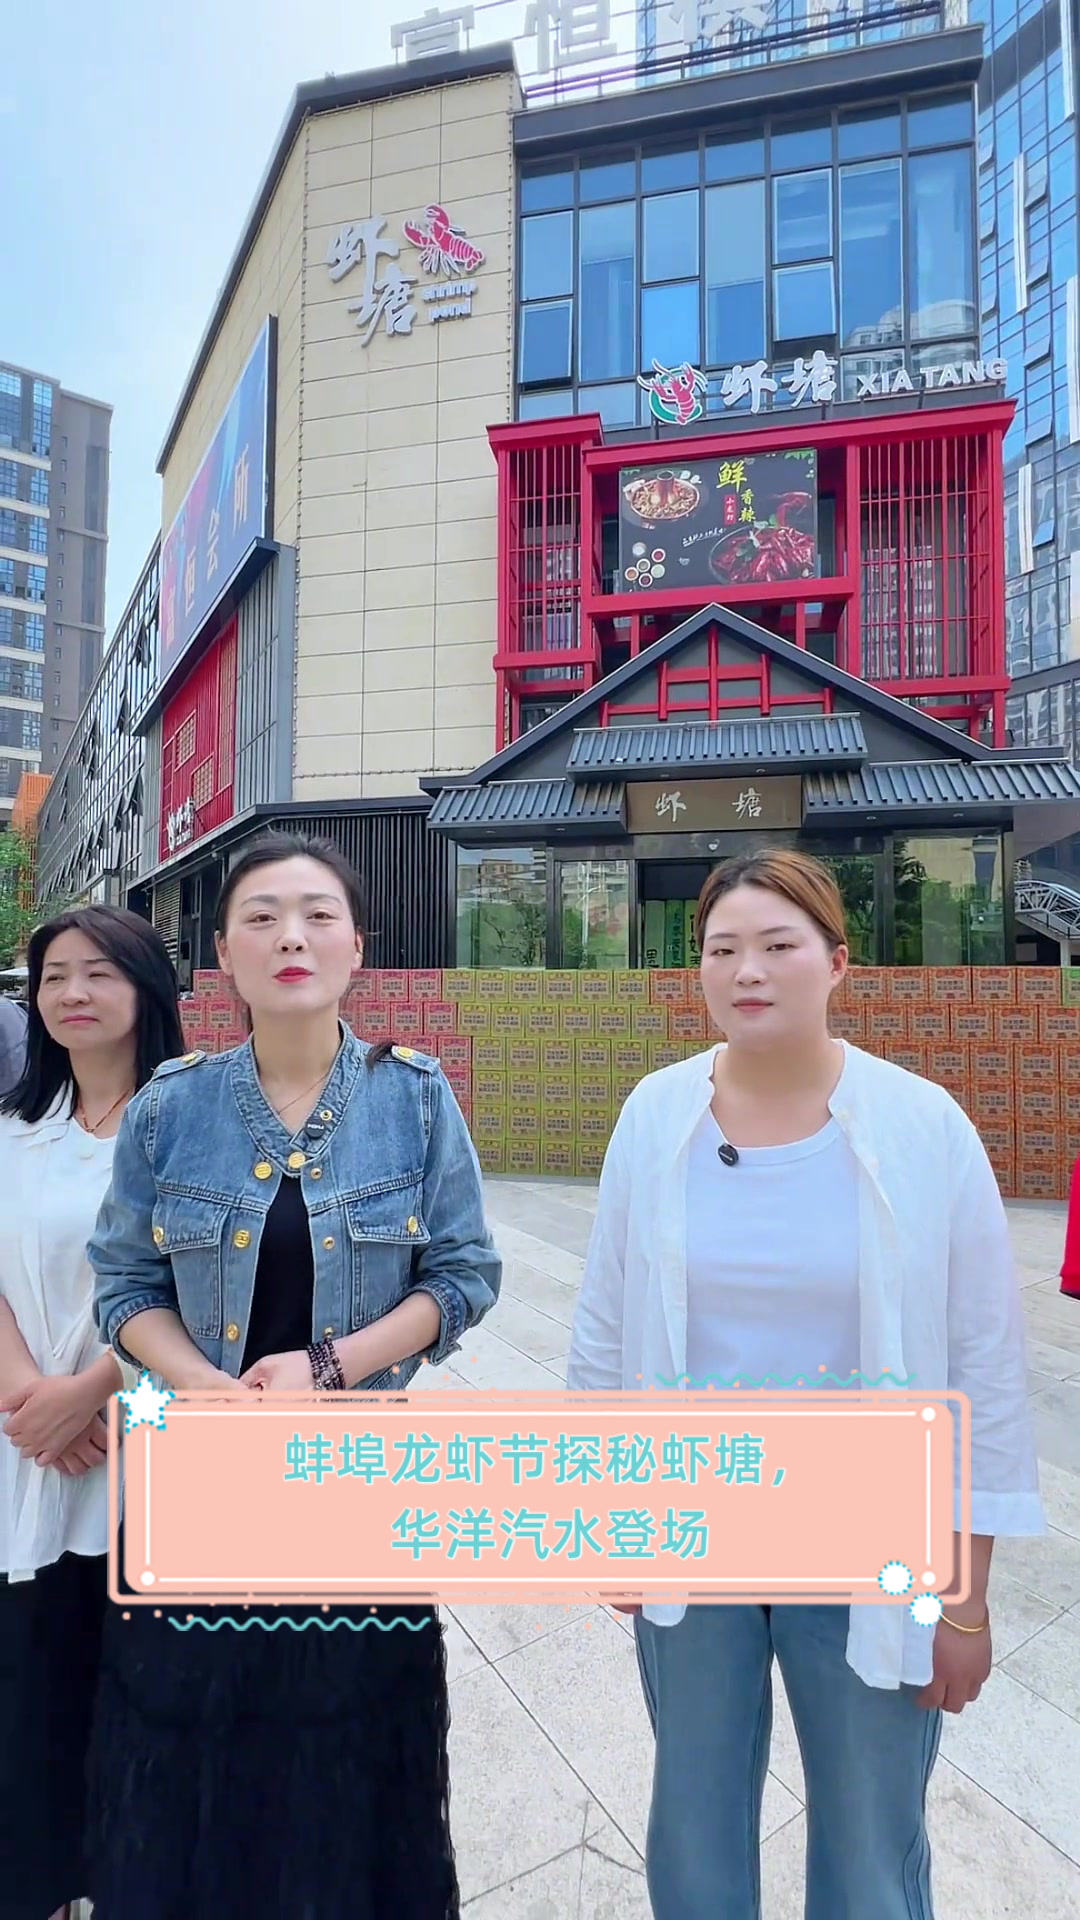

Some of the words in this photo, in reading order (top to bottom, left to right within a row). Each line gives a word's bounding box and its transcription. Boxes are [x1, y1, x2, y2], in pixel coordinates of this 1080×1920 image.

[324, 213, 419, 348] 虾塘
[720, 350, 838, 414] 虾塘
[857, 370, 914, 396] XIA
[920, 358, 1008, 388] TANG
[716, 460, 747, 493] 鲜
[655, 787, 762, 823] 虾塘
